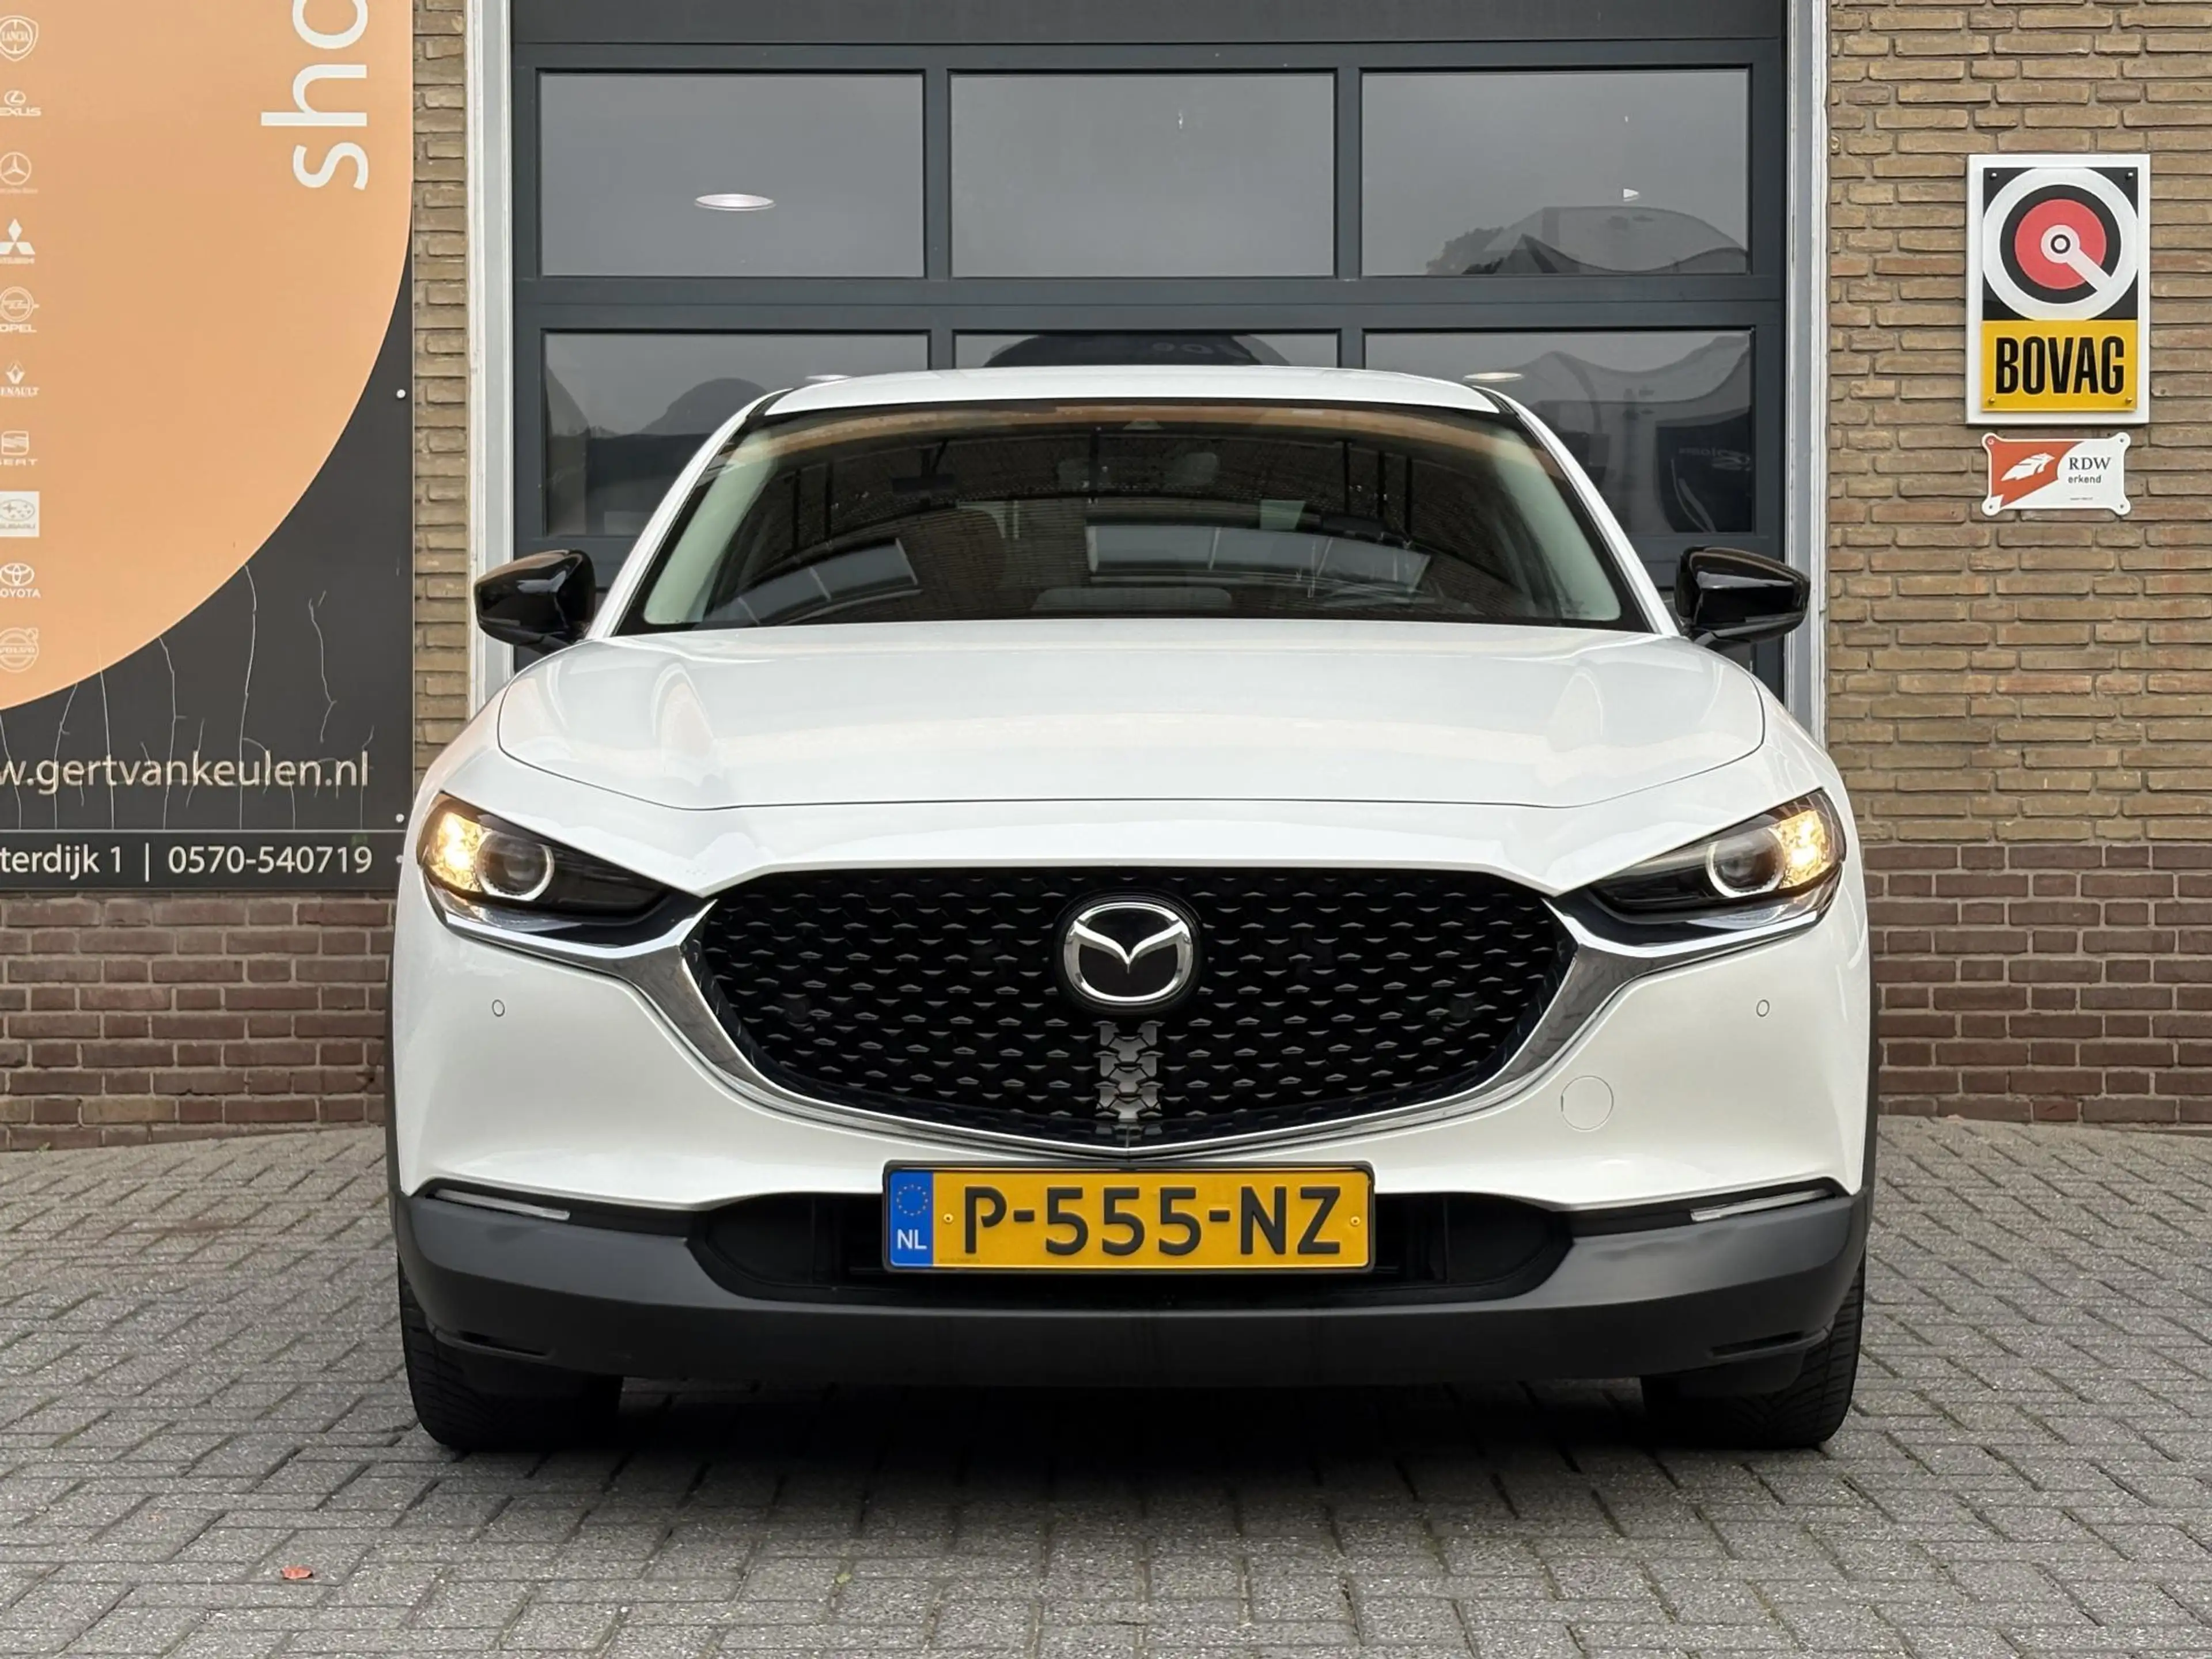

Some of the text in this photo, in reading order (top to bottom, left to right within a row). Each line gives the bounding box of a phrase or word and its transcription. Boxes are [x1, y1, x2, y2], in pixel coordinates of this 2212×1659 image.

[260, 0, 369, 190] sho
[1995, 336, 2124, 395] BOVAG
[2067, 474, 2102, 484] erkend
[2068, 457, 2111, 471] RDW
[110, 846, 122, 873] 1
[168, 845, 373, 874] 0570-540719
[897, 1185, 1342, 1257] NL P-555-NZ
